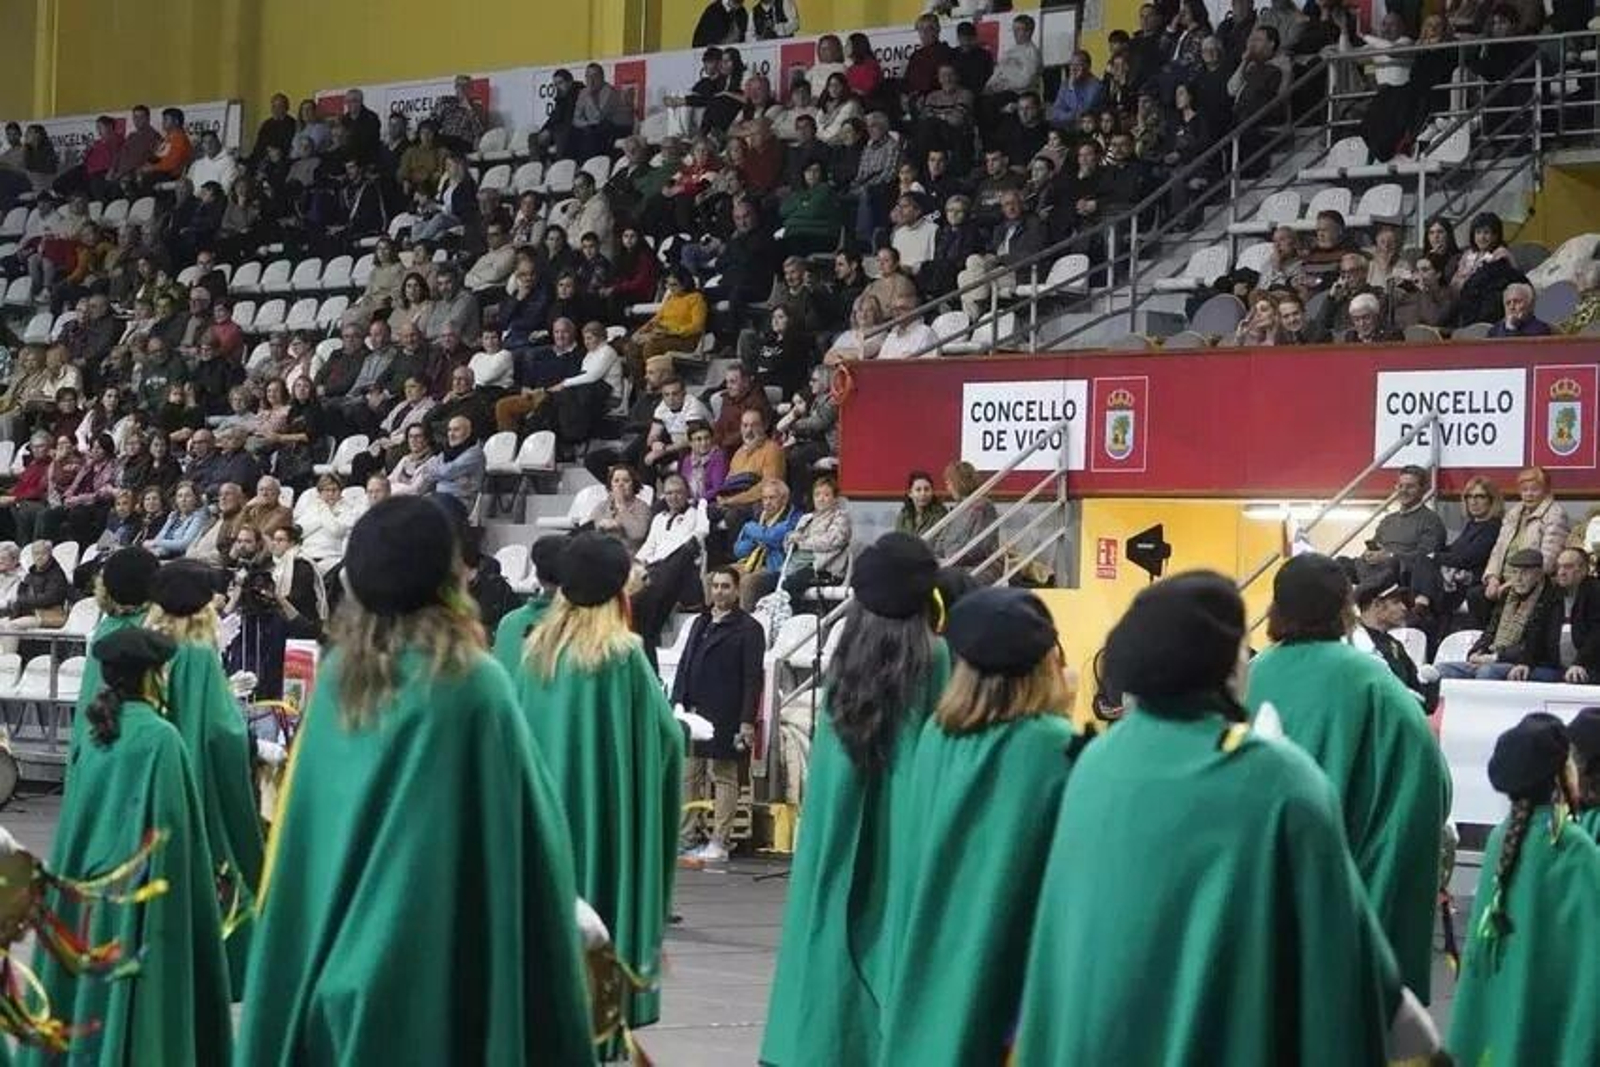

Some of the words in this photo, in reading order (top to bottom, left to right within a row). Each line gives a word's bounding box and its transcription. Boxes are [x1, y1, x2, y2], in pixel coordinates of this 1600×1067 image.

[874, 44, 921, 62] CONCE
[391, 97, 434, 114] CONCEL
[970, 400, 1077, 422] CONCELLO
[1386, 390, 1513, 415] CONCELLO
[982, 430, 1007, 451] DE
[1438, 422, 1497, 446] VIGO
